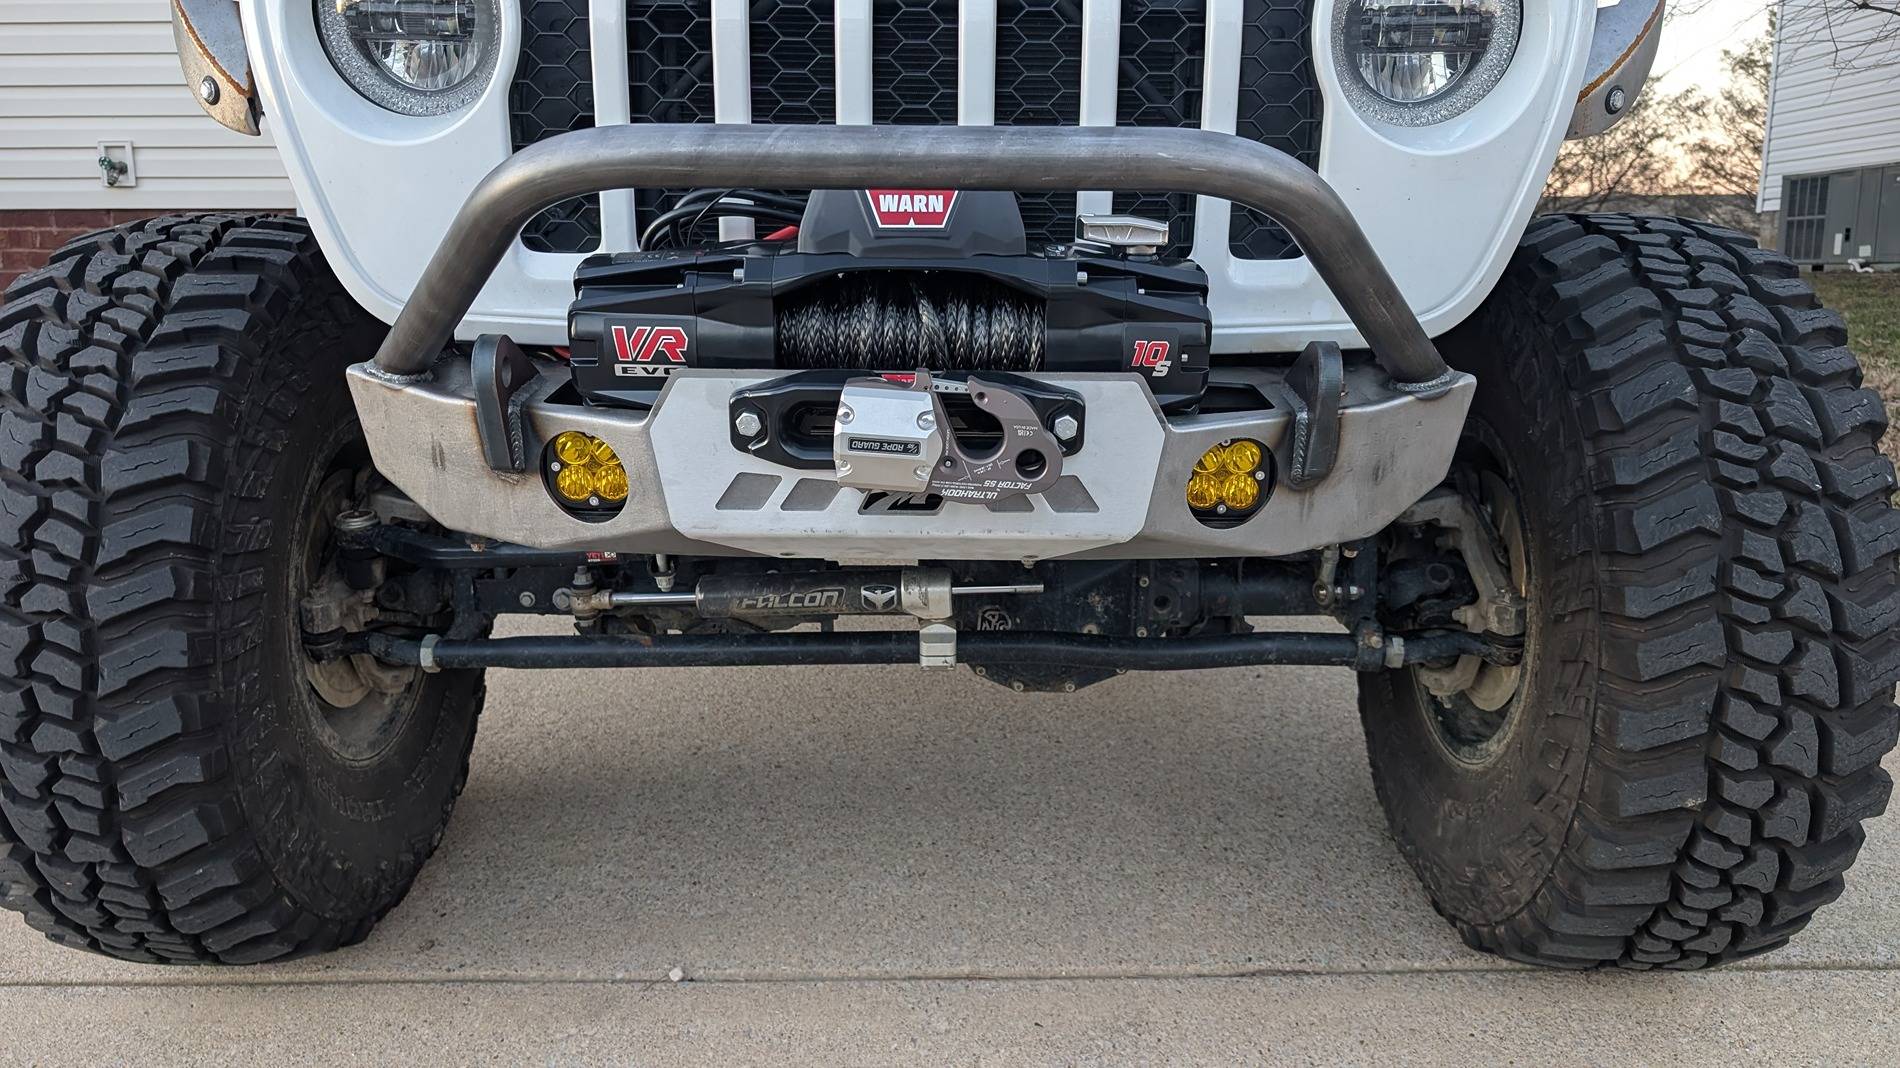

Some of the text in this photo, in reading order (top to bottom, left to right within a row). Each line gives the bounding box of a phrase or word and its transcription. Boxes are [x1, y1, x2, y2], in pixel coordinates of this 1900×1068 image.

[879, 195, 943, 213] WARN
[611, 326, 688, 362] VR
[851, 440, 880, 450] GUARD
[881, 442, 904, 451] ROPE
[997, 480, 1032, 490] FACTOR
[940, 488, 998, 500] ULTRAHOOK
[740, 591, 839, 609] FALCON
